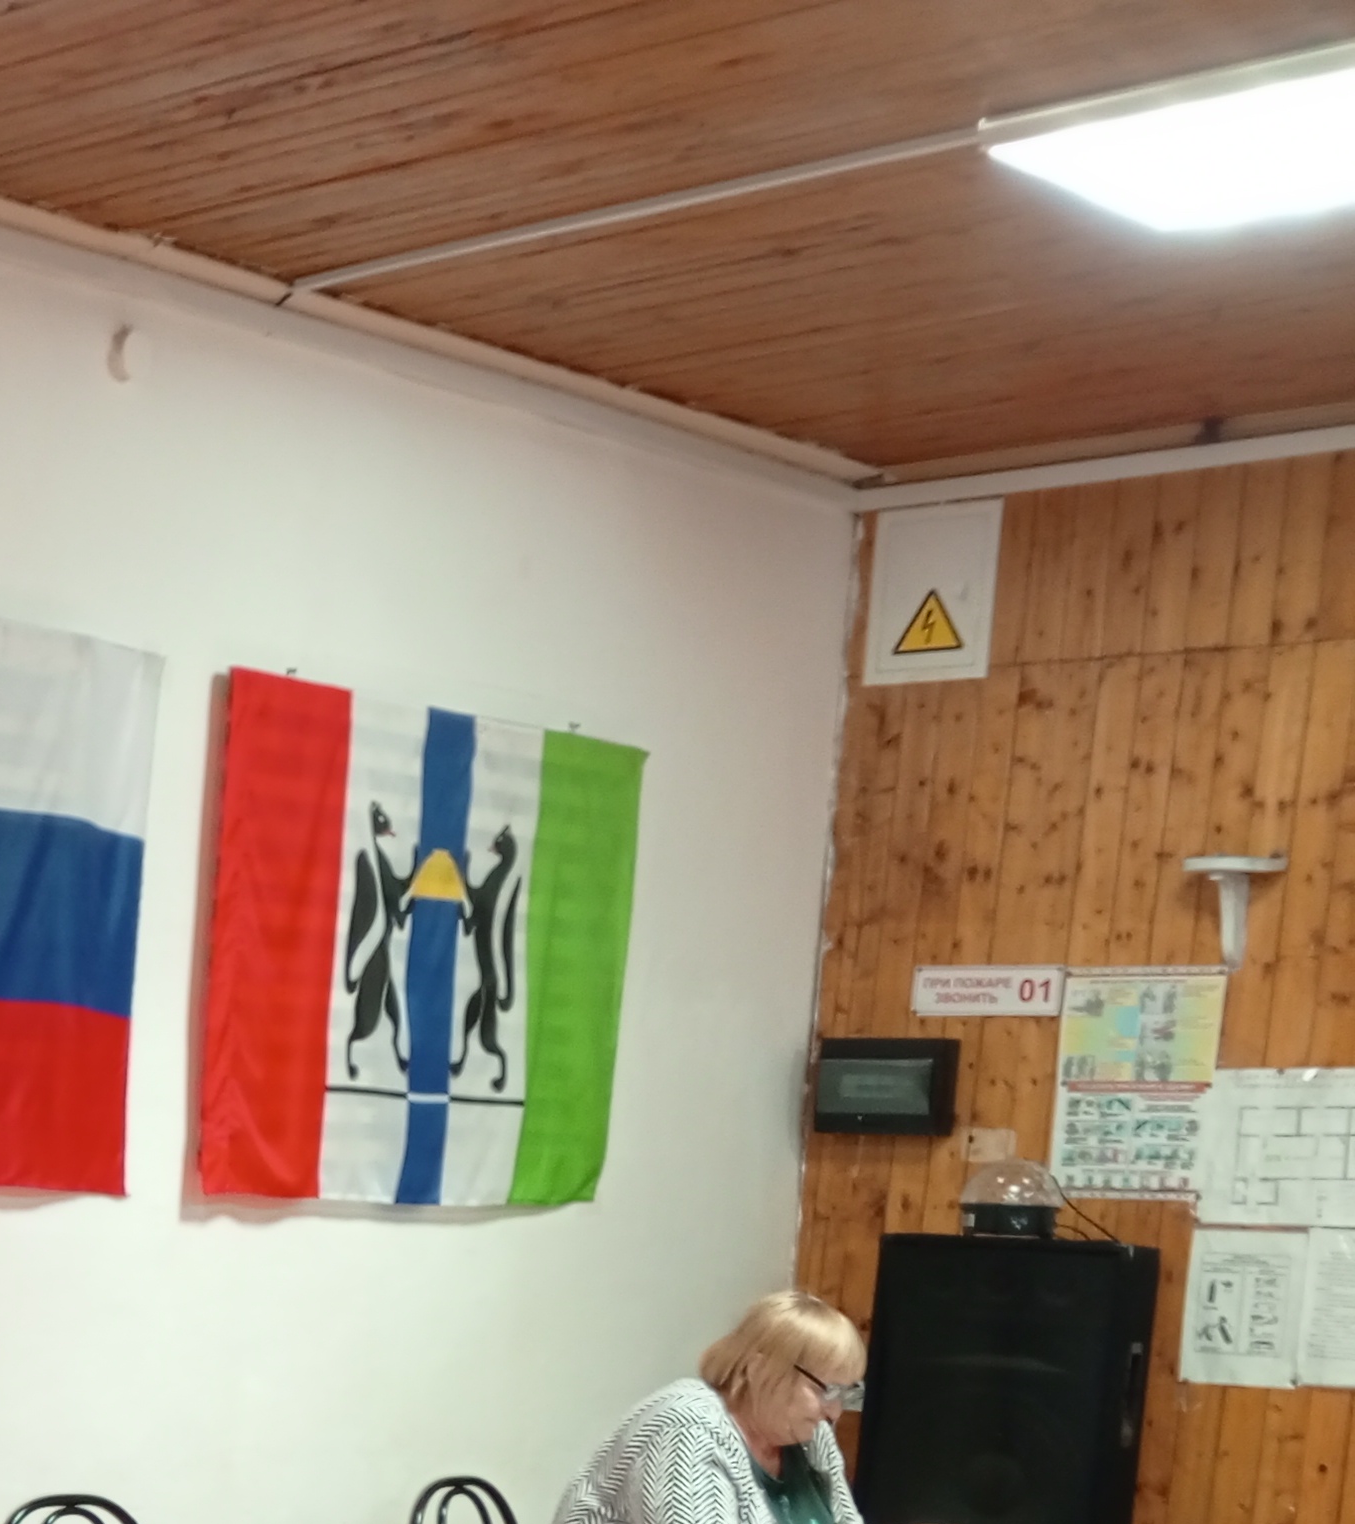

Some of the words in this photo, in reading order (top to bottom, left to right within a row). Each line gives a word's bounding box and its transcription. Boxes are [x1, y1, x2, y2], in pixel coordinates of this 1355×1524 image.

[923, 977, 951, 988] ПРИ
[952, 977, 1012, 988] ПОЖАРЕ
[1019, 978, 1051, 1003] 01
[934, 992, 998, 1004] ЗВОНИТЬ
